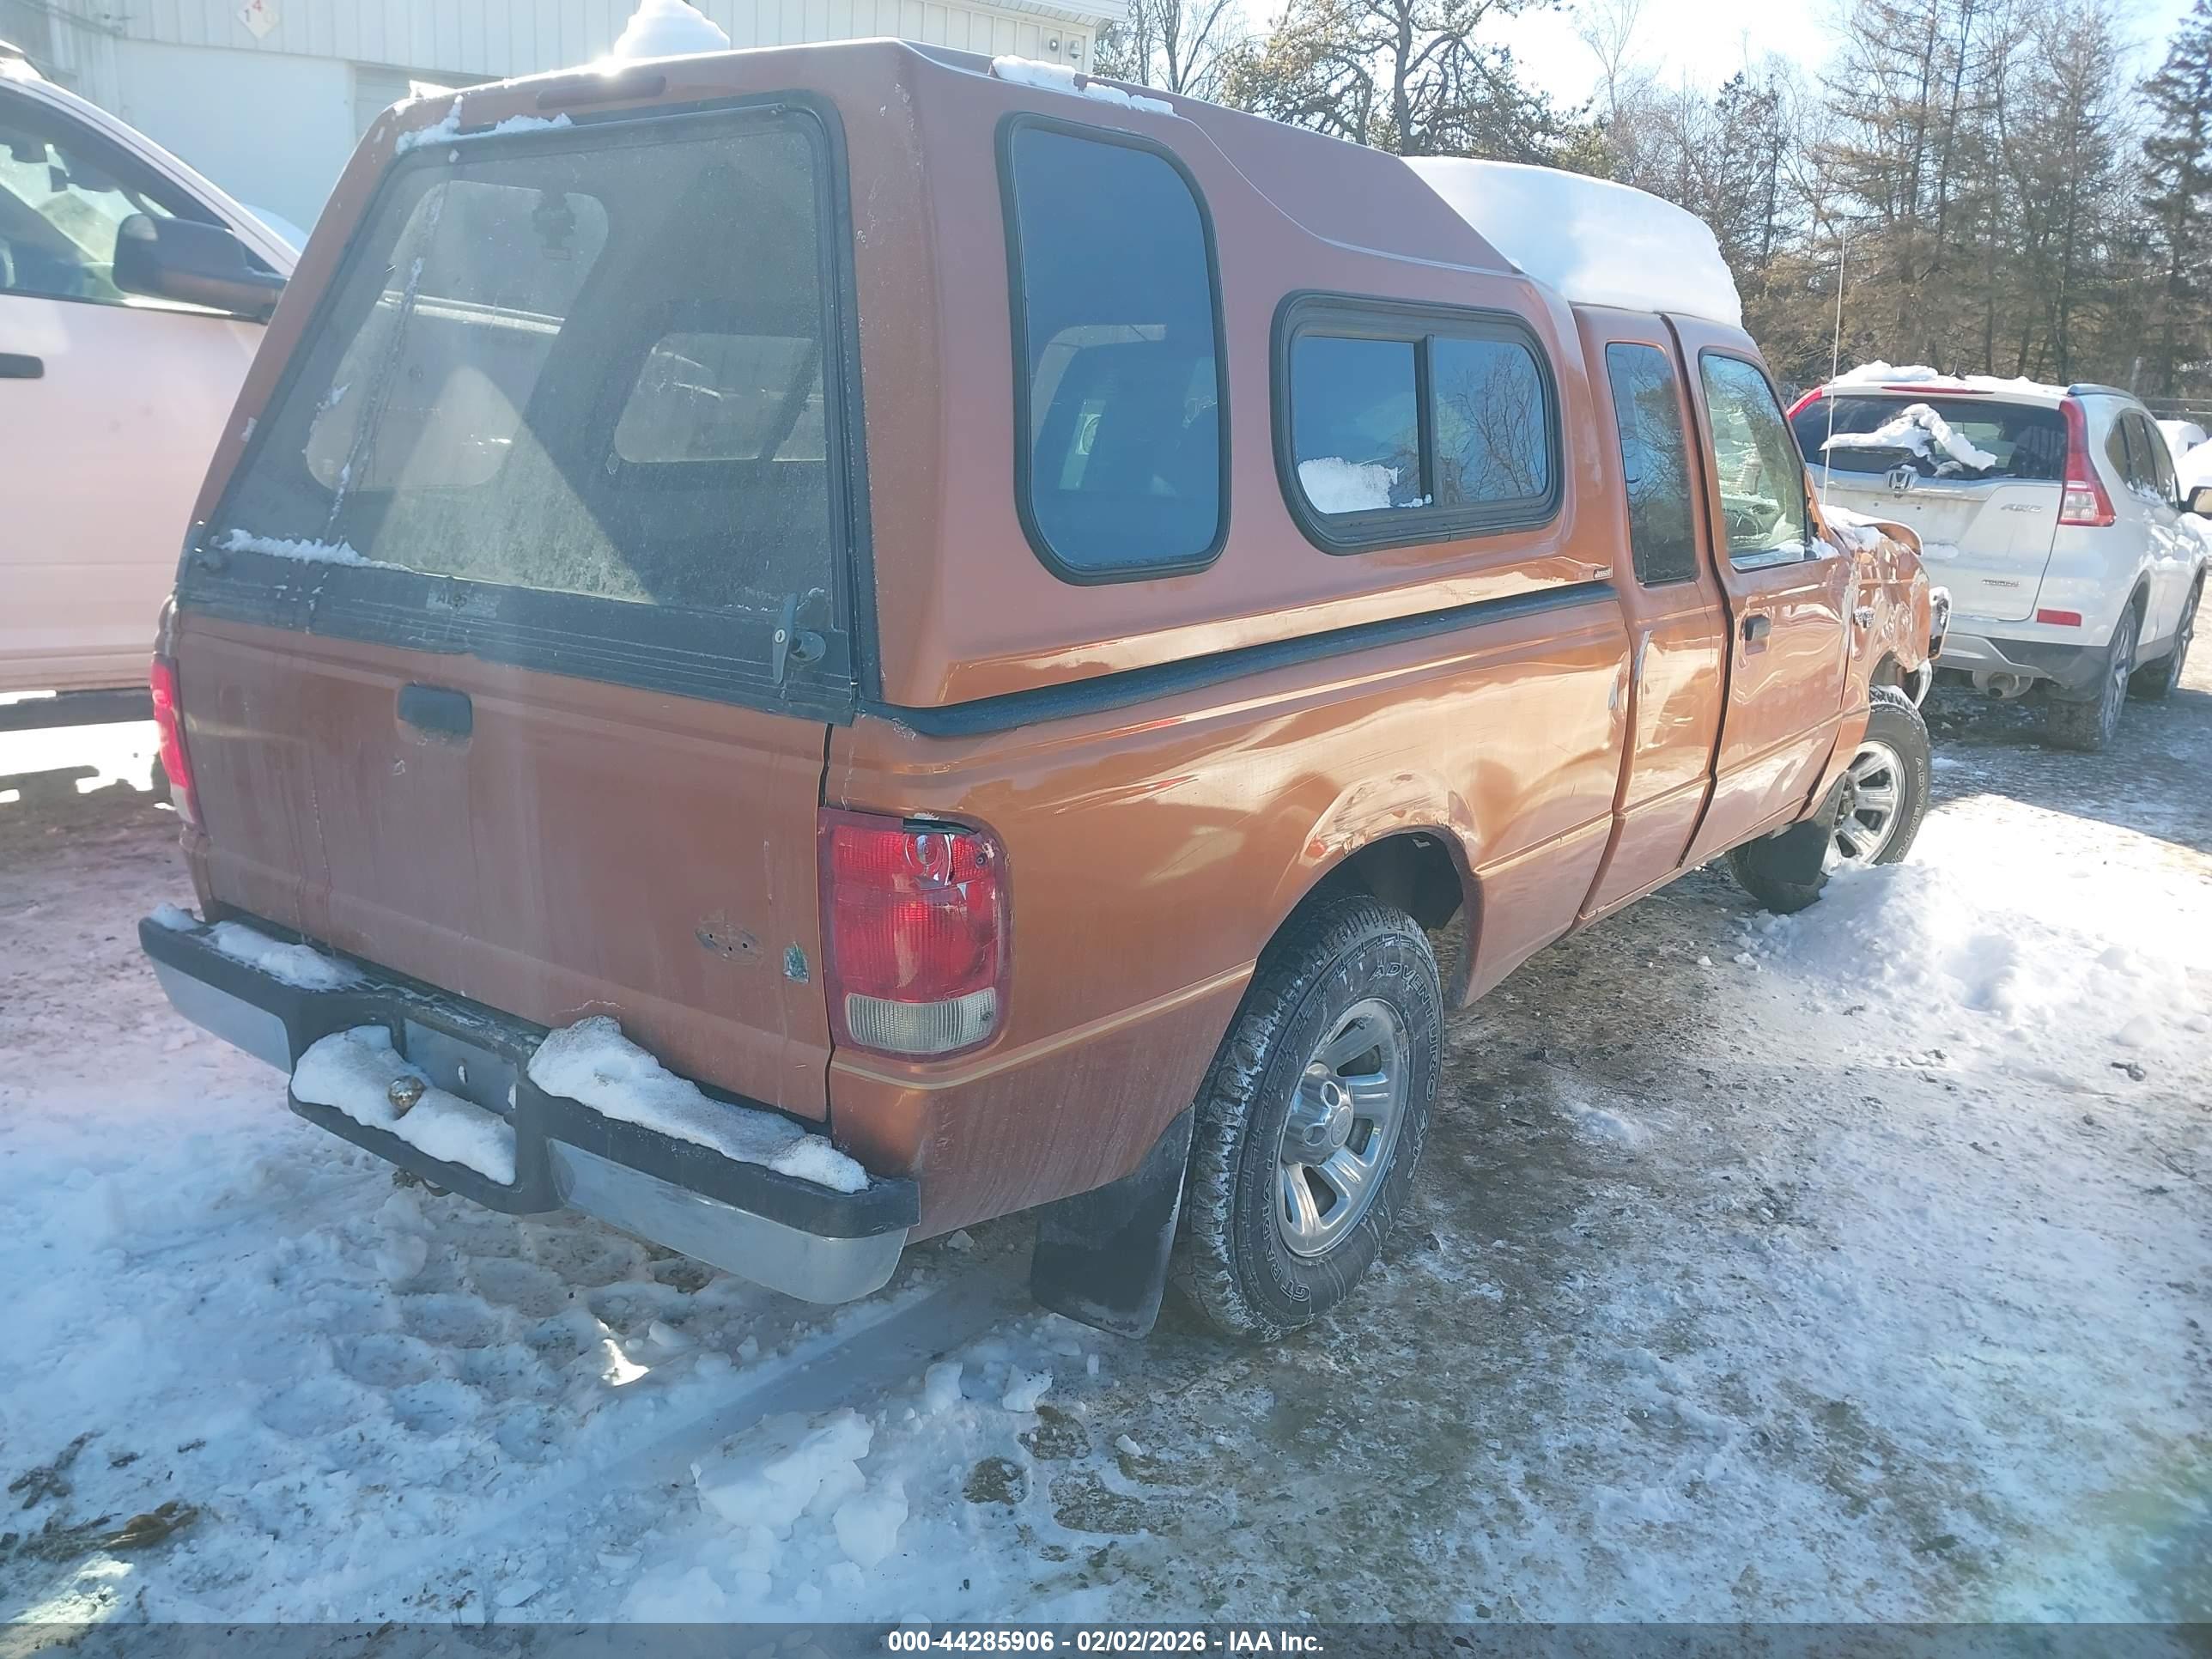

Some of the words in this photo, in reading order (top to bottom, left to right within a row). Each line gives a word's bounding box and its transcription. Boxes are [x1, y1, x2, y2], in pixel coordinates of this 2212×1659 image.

[1368, 962, 1438, 1101] ADVENTURO
[1263, 1151, 1284, 1281] RADIAL
[1279, 1279, 1311, 1302] GT
